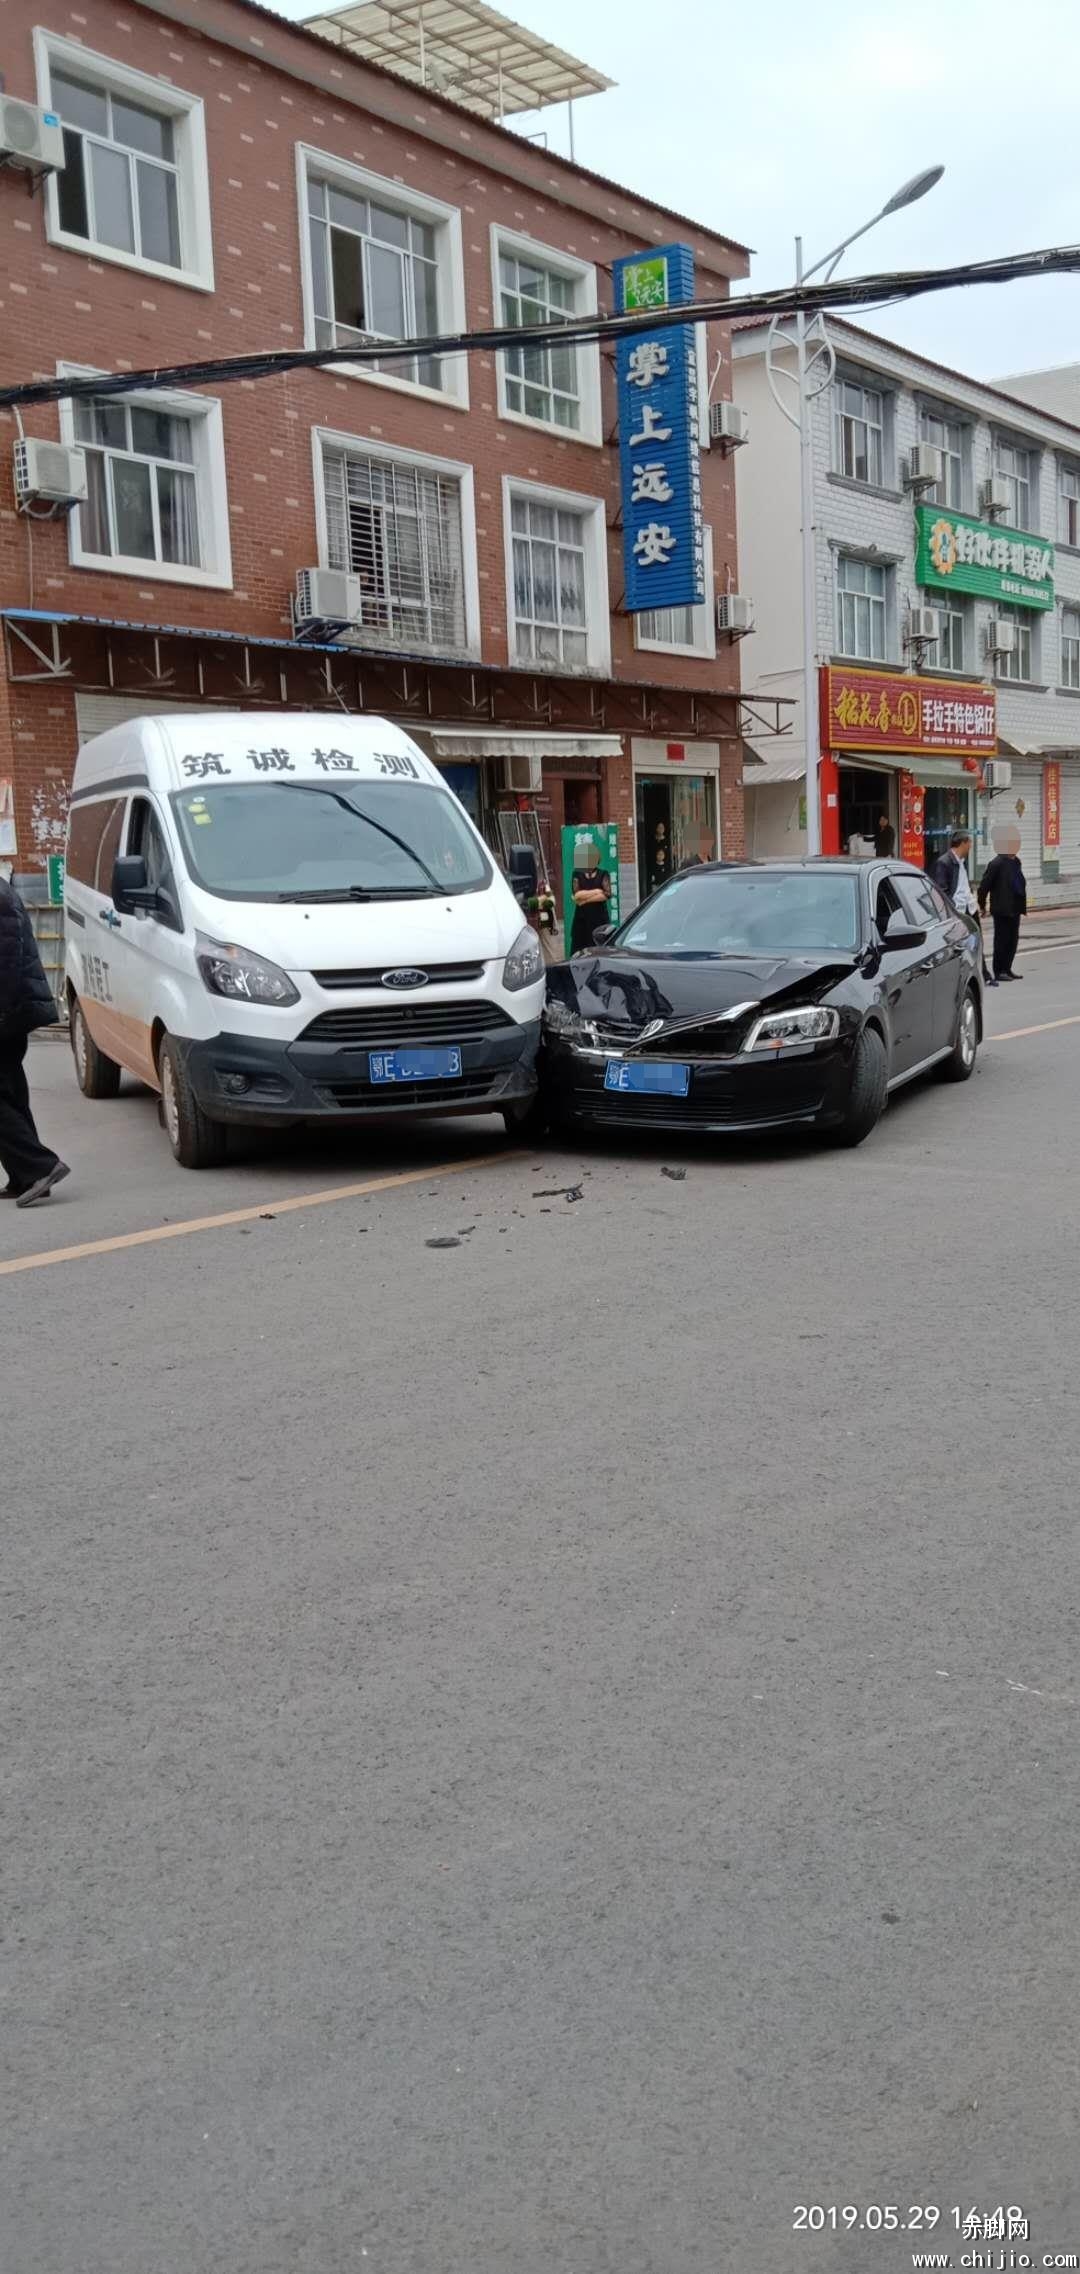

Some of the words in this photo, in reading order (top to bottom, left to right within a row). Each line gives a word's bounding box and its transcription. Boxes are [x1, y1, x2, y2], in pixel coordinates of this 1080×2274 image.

[626, 342, 677, 566] 掌上远安
[922, 699, 994, 736] 手拉手特色锅仔
[181, 748, 420, 779] 筑诚检测
